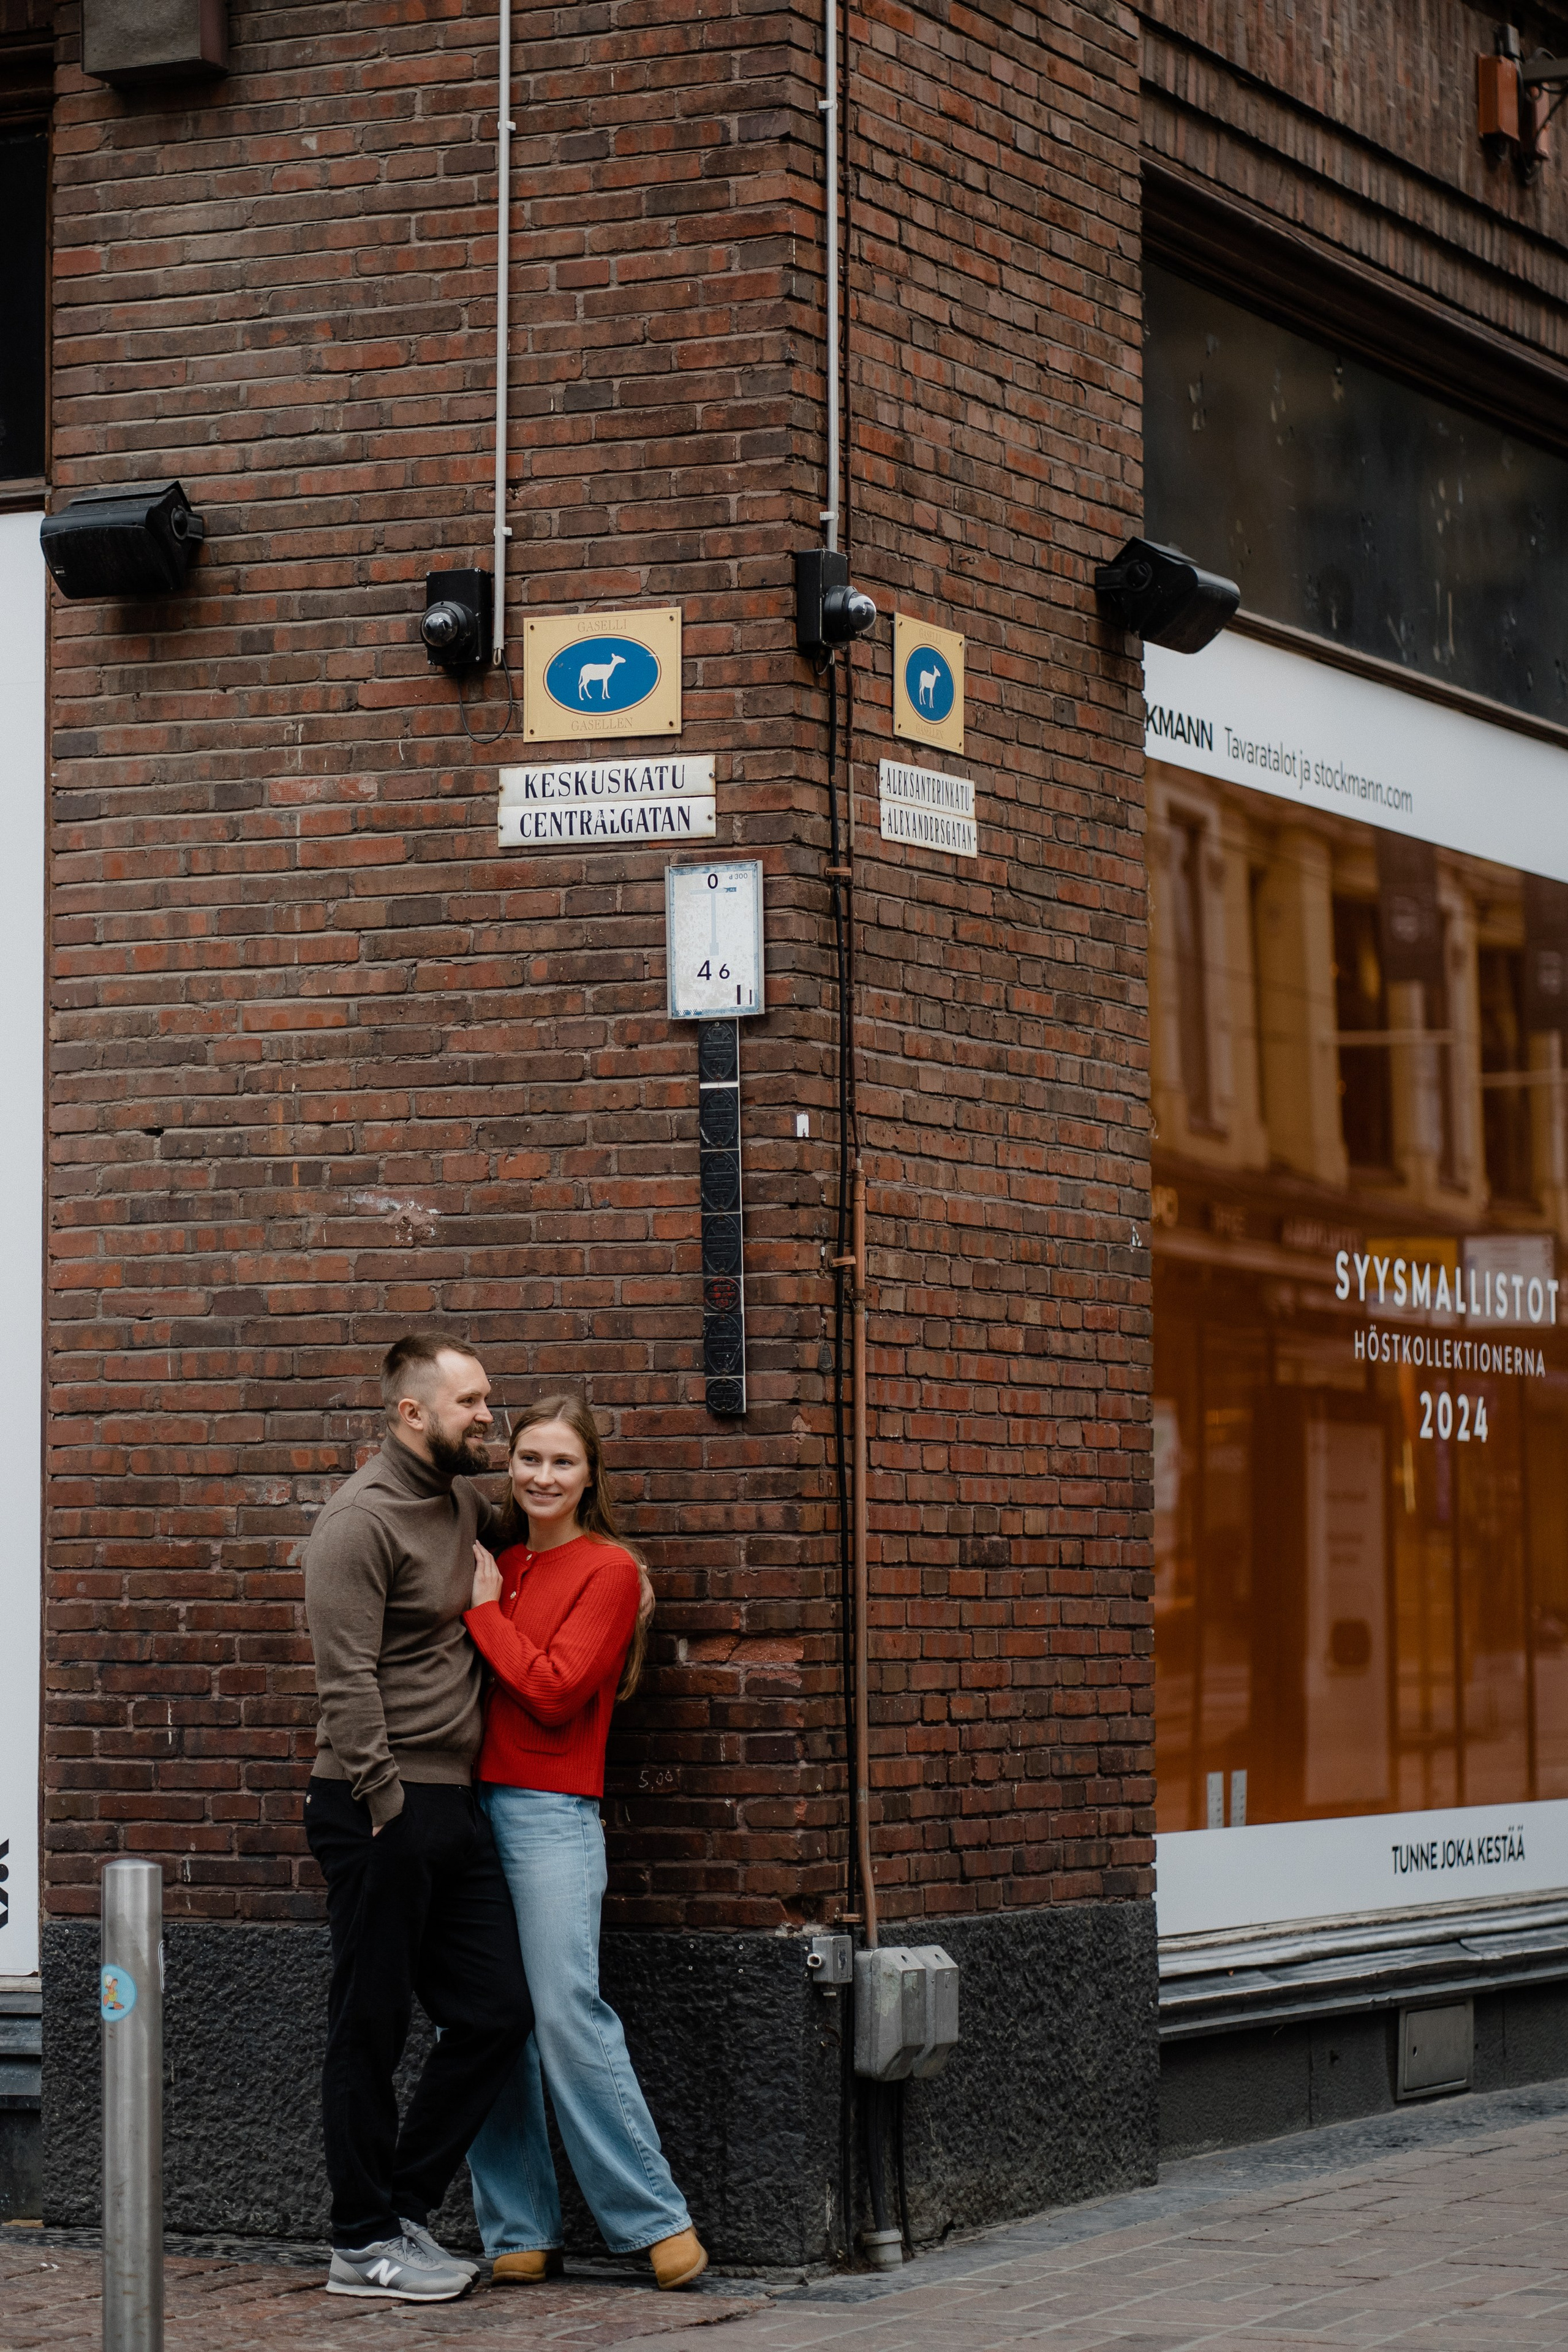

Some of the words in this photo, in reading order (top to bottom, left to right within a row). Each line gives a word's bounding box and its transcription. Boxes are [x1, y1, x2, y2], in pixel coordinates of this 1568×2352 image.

[577, 619, 627, 633] GASELLI
[918, 627, 941, 645] GASELLI
[570, 717, 633, 732] GASELLEN
[915, 723, 944, 741] GASELLEN
[524, 763, 686, 800] KESKUSKATU
[886, 767, 970, 812] ALEKSANTERINKATU
[1224, 726, 1298, 778] Tavaratalot
[1298, 749, 1311, 790] ja
[1314, 761, 1414, 814] stockmann.com
[519, 805, 692, 839] CENTRALGATAN
[887, 806, 973, 851] ALEXANDERSGATAN
[1335, 1250, 1559, 1325] SYYSMALLISTOT
[1354, 1324, 1547, 1378] HÖSTKOLLEKTIONERNA
[1419, 1390, 1489, 1444] 2024
[1391, 1839, 1439, 1875] TUNNE
[1441, 1838, 1476, 1871] JOKA
[1477, 1824, 1526, 1866] KESTÄÄ
